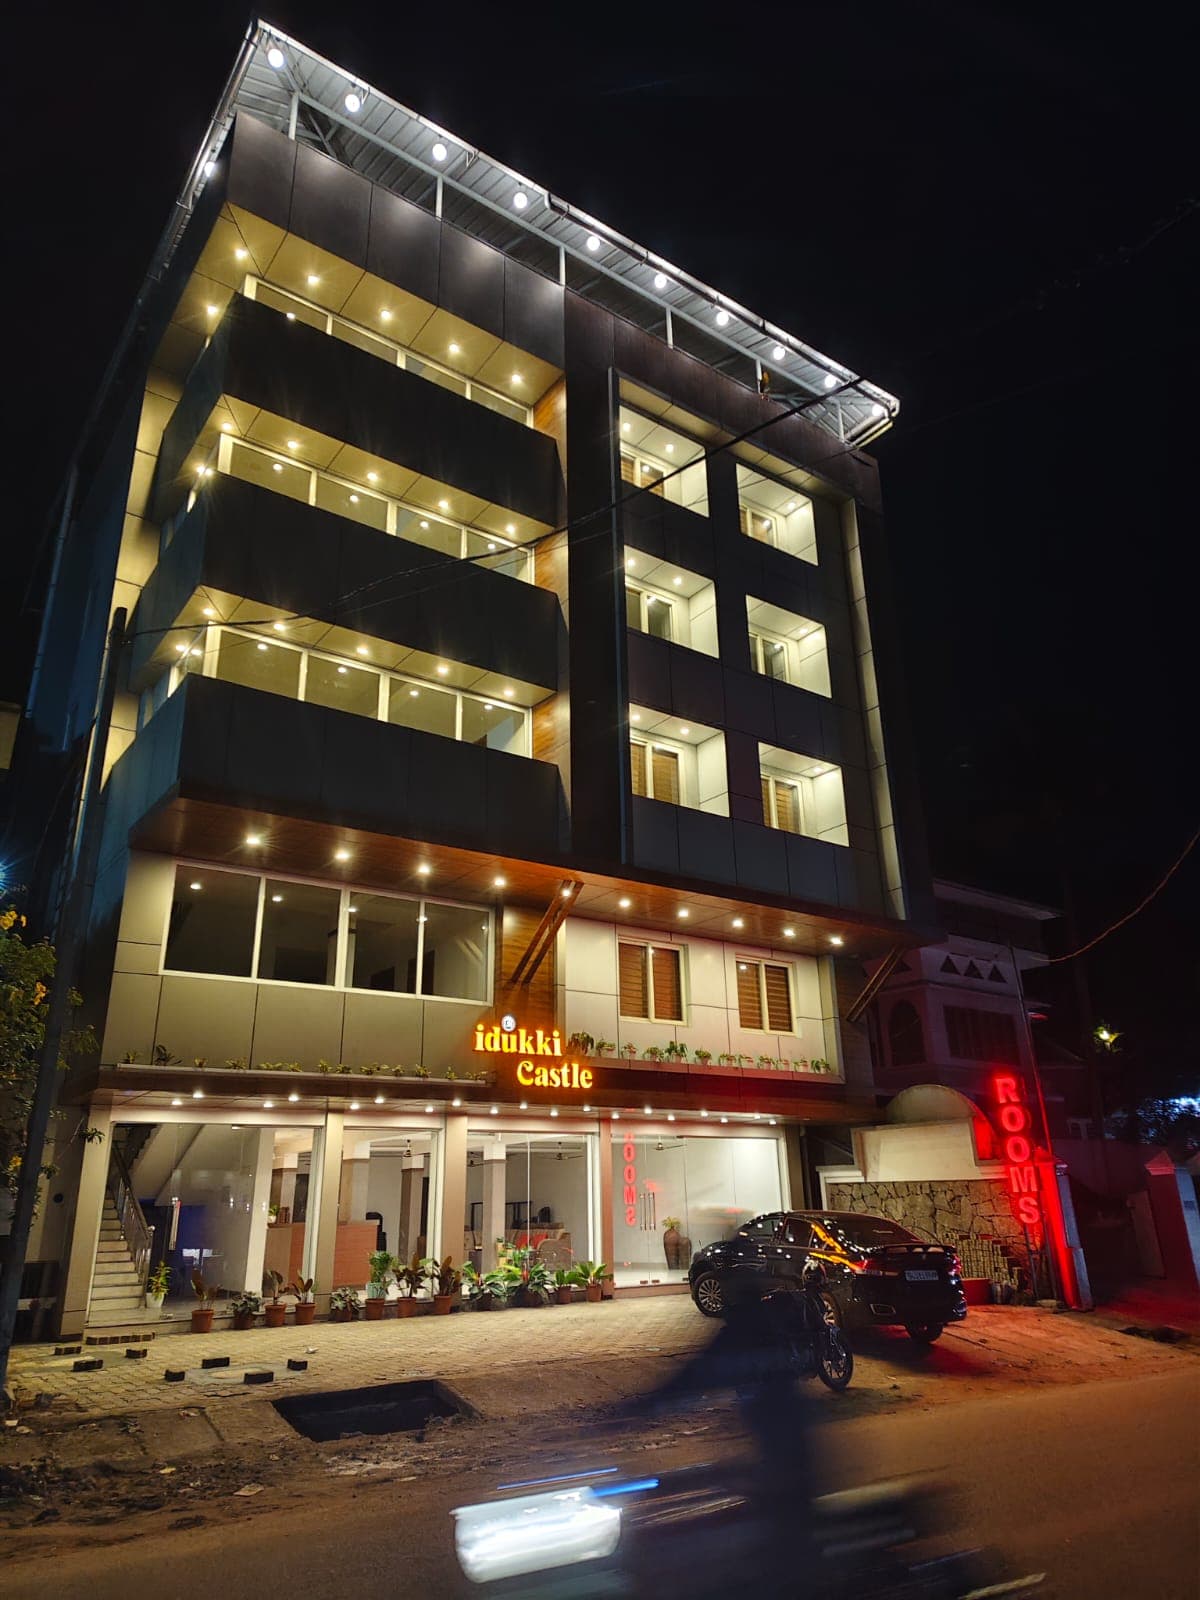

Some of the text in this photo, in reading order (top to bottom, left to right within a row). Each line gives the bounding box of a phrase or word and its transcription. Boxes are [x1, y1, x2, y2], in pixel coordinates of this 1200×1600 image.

[474, 1023, 562, 1056] idukki
[516, 1060, 593, 1089] Castle
[995, 1077, 1040, 1224] ROOMS
